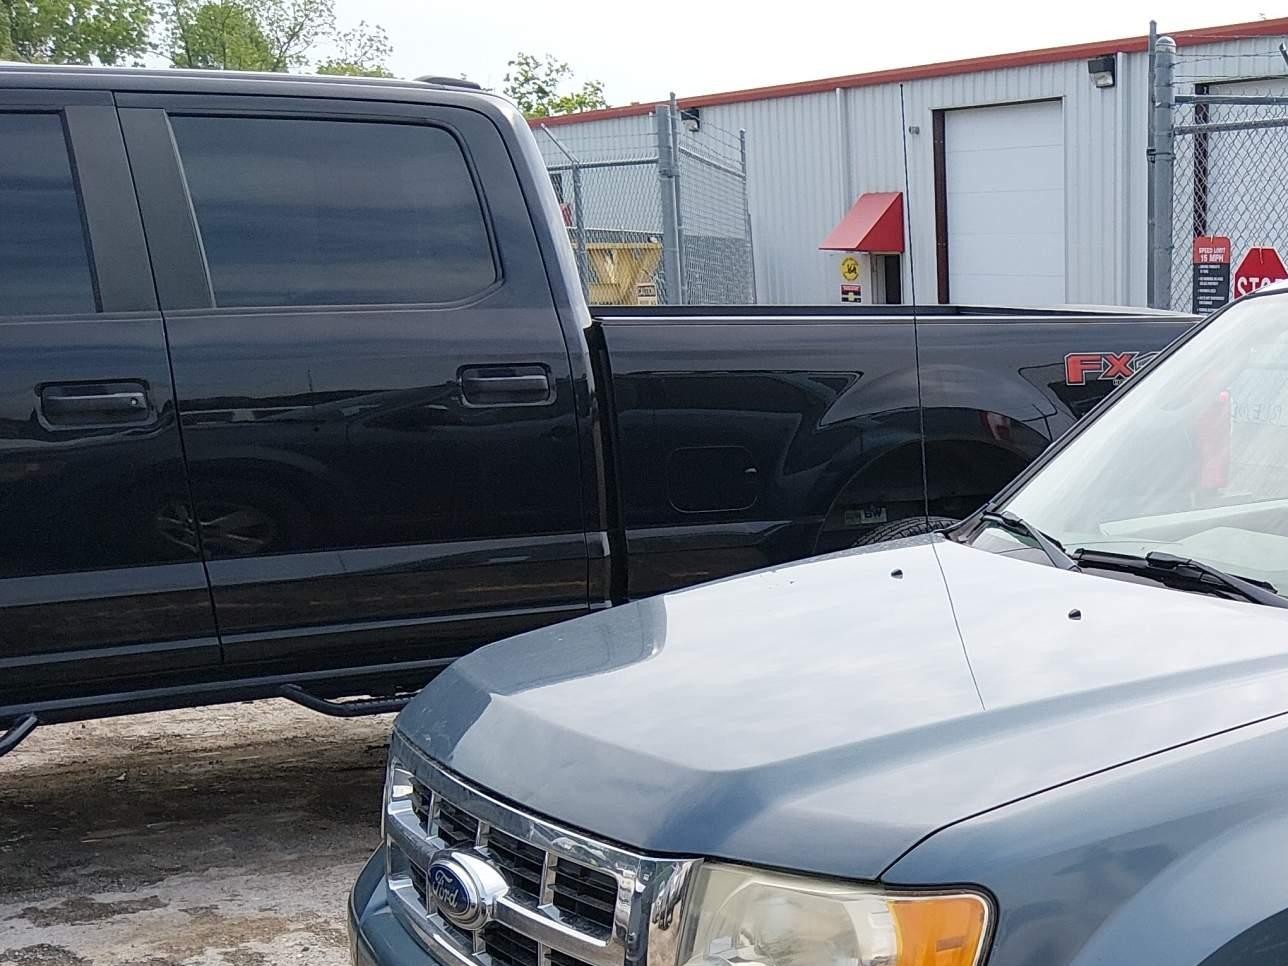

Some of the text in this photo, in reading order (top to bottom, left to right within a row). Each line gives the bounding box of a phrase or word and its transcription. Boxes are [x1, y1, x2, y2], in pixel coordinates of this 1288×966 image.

[1200, 254, 1224, 262] 15 MPH
[1237, 276, 1288, 296] ST
[431, 869, 460, 908] Ford
